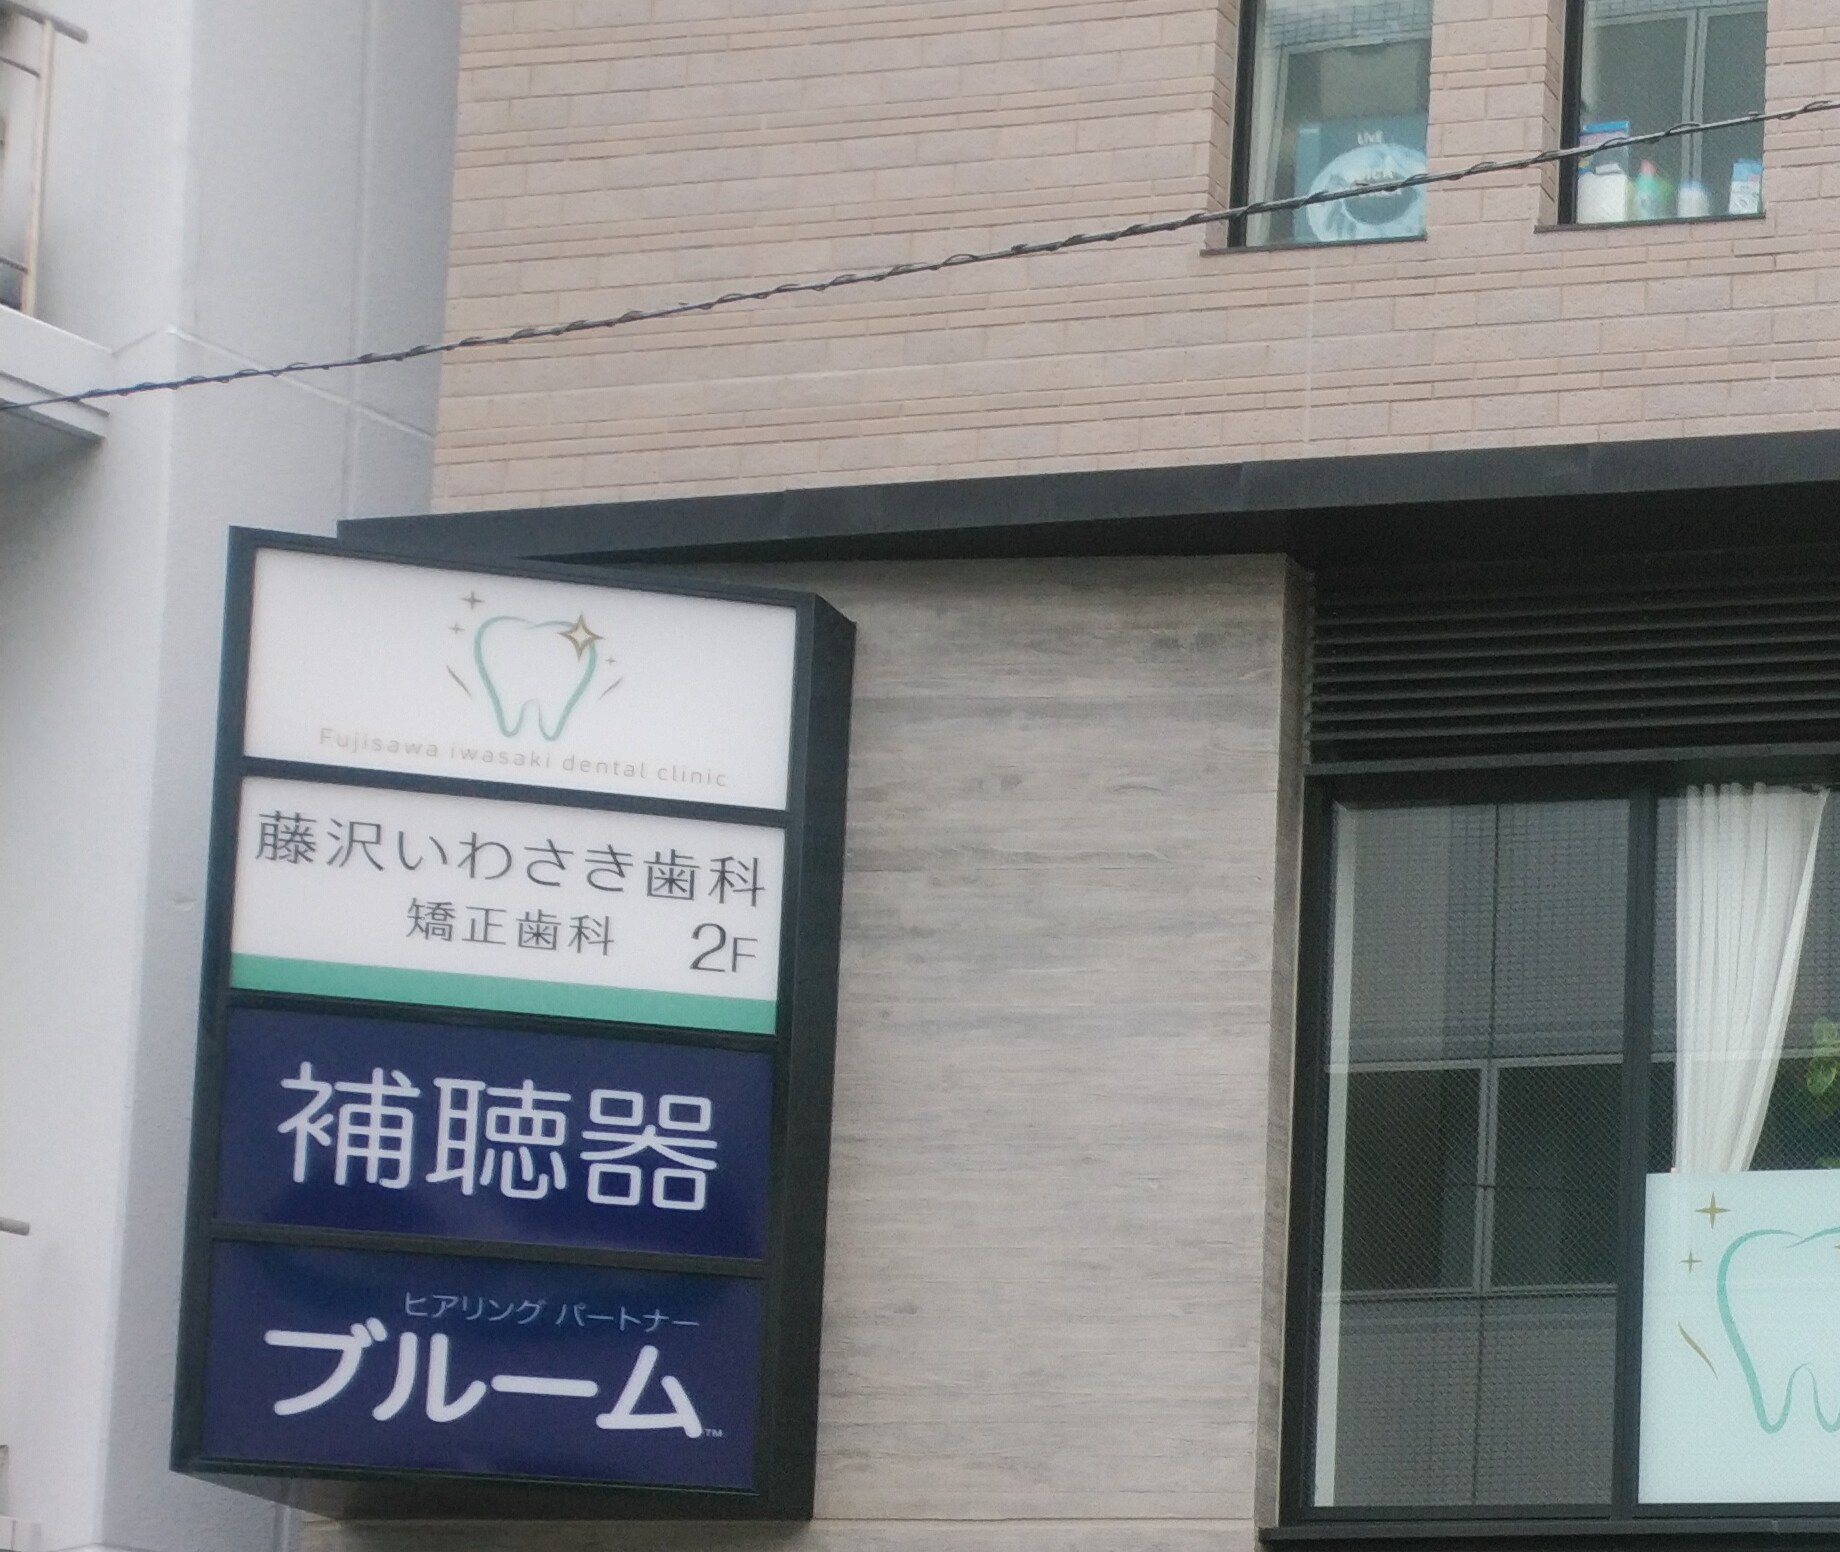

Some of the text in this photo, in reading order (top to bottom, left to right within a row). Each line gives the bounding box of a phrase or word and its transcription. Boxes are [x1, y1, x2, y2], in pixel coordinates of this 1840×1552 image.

[317, 727, 728, 788] Fujisawa iwasaki dental clinic
[254, 811, 766, 908] 藤沢いわさき歯科
[406, 897, 759, 975] 矯正歯科 2F
[278, 1061, 718, 1211] 補聴器
[404, 1292, 700, 1330] ヒアリング パートナー
[264, 1316, 704, 1439] ブルーム
